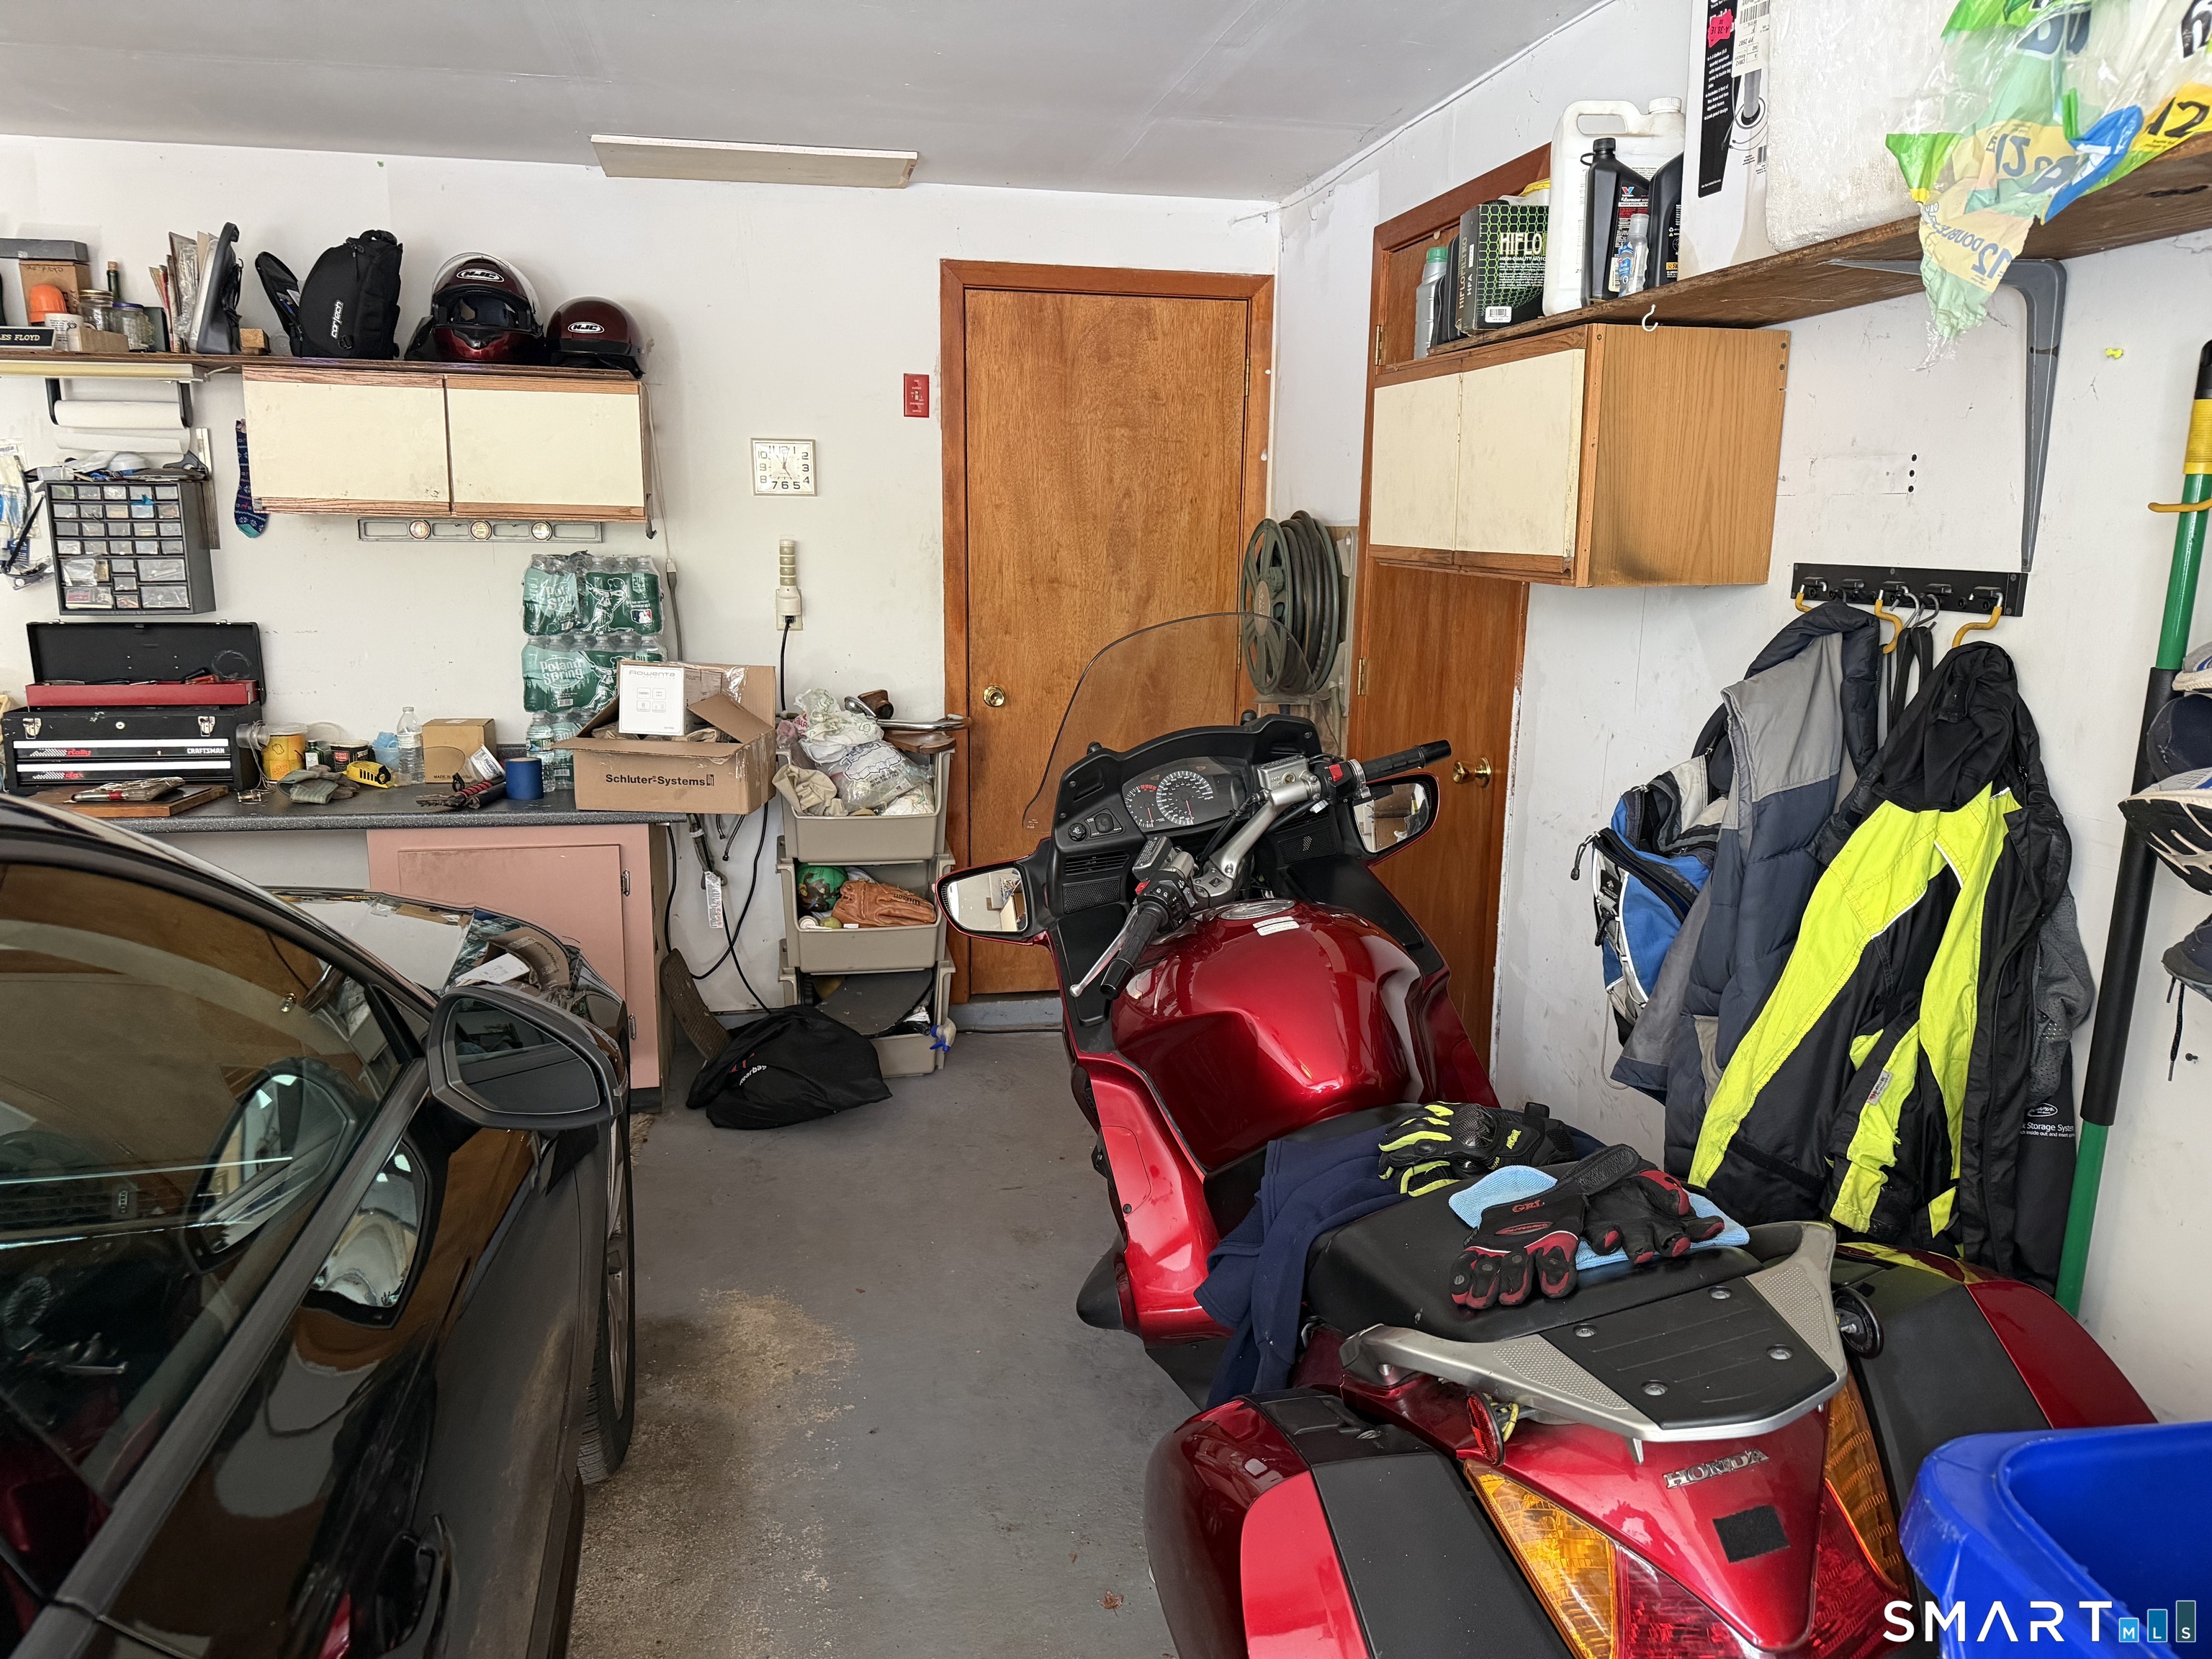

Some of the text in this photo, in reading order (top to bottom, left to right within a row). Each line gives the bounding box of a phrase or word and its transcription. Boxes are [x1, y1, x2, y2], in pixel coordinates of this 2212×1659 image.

[2146, 96, 2211, 139] 12
[1498, 232, 1544, 256] HIFLO
[1458, 236, 1468, 310] HIFLOFILTRO
[331, 299, 344, 338] cortech
[14, 333, 41, 342] FLOYD
[801, 451, 809, 460] 2
[771, 481, 778, 490] 7
[781, 481, 788, 490] 6
[793, 481, 801, 490] 5
[802, 476, 810, 485] 4
[539, 657, 584, 673] Poland
[541, 667, 585, 686] Spring
[2026, 1122, 2056, 1133] Storage
[1512, 1200, 1545, 1213] GEL
[1662, 1448, 1770, 1490] HONDA
